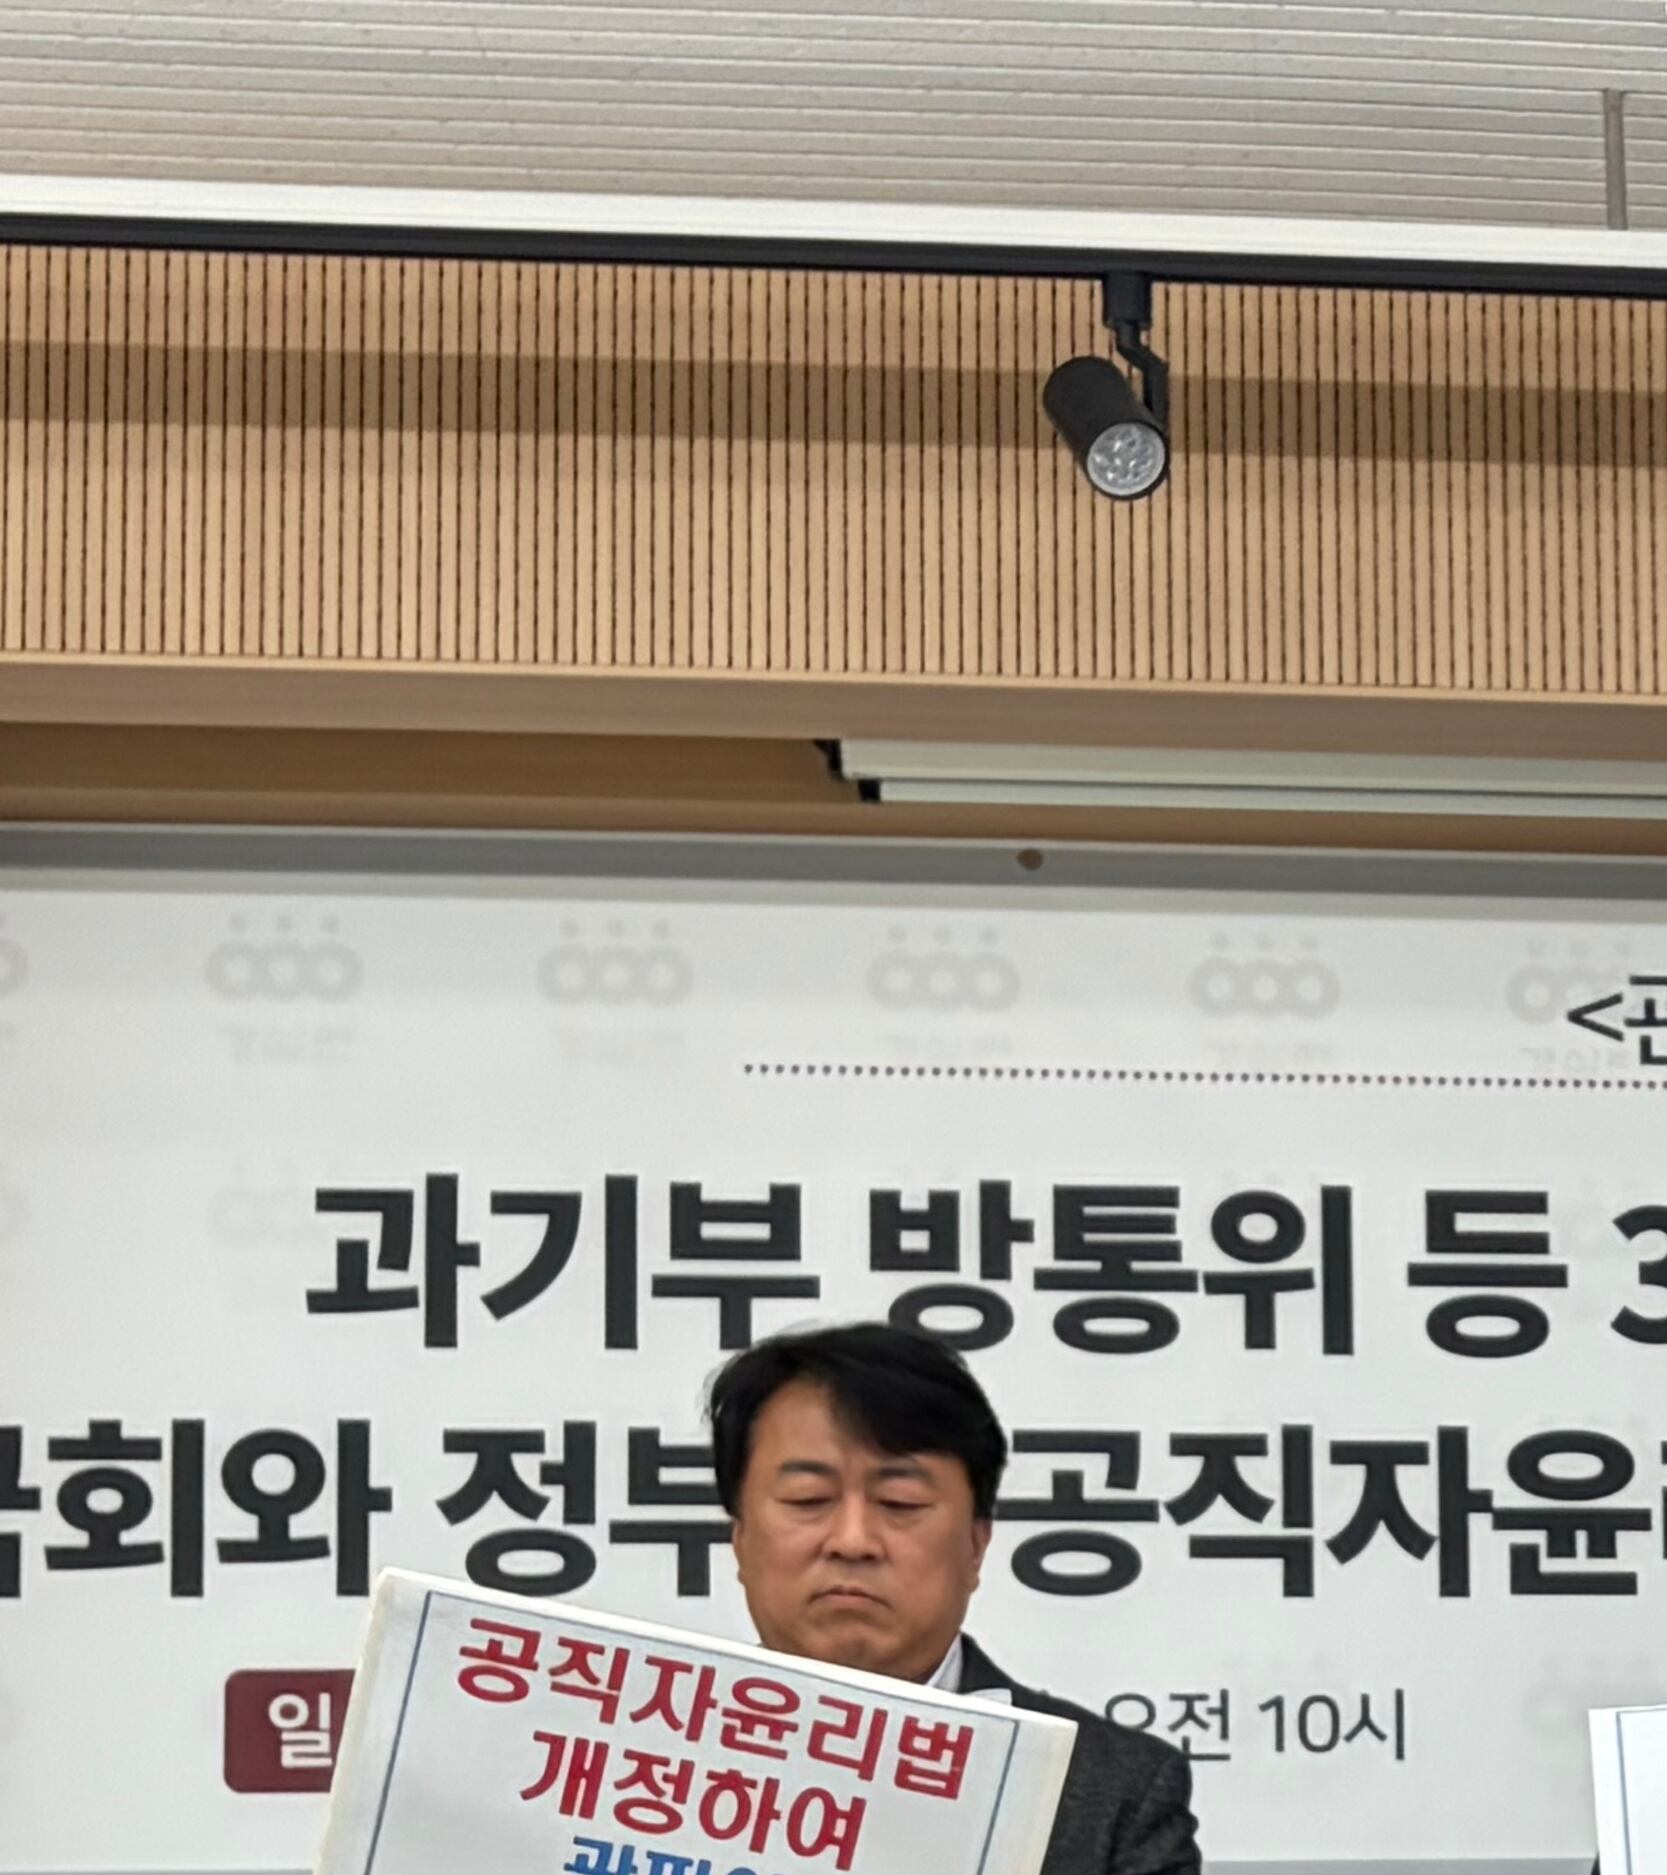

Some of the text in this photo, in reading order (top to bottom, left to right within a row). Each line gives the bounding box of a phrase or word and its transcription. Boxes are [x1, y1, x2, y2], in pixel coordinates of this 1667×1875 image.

[306, 1172, 821, 1350] 과기부
[868, 1179, 1355, 1357] 방통위
[1407, 1189, 1568, 1358] 등
[435, 1420, 734, 1597] 정부
[457, 1618, 974, 1801] 공직자윤리법
[1258, 1687, 1405, 1762] 10시
[519, 1729, 867, 1872] 개정하여
